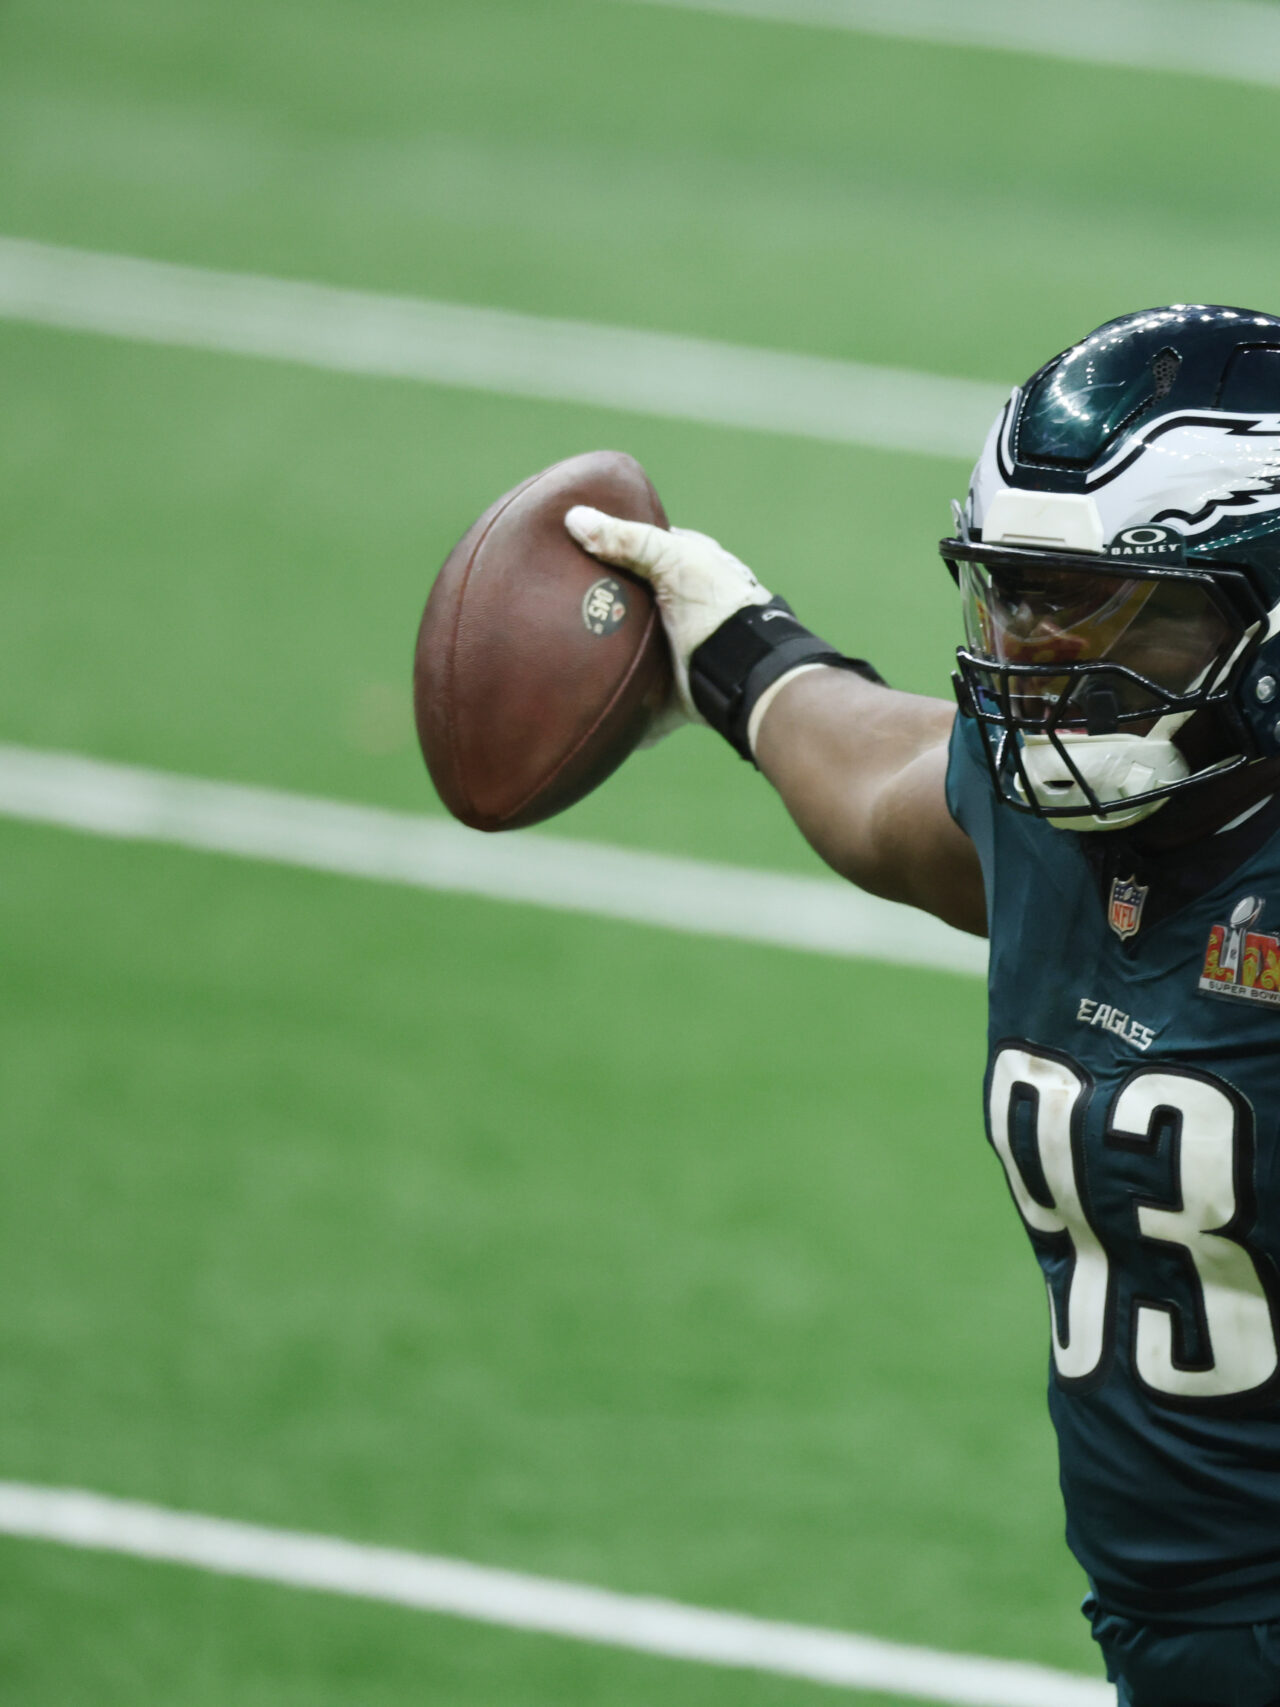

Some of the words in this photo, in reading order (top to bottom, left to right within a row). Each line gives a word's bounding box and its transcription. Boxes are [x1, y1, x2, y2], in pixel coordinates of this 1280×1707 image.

[1111, 544, 1179, 555] OAKLEY
[1112, 903, 1135, 929] NFL
[1208, 980, 1247, 995] SUPER
[1077, 998, 1156, 1051] EAGLES
[989, 1048, 1279, 1398] 93
